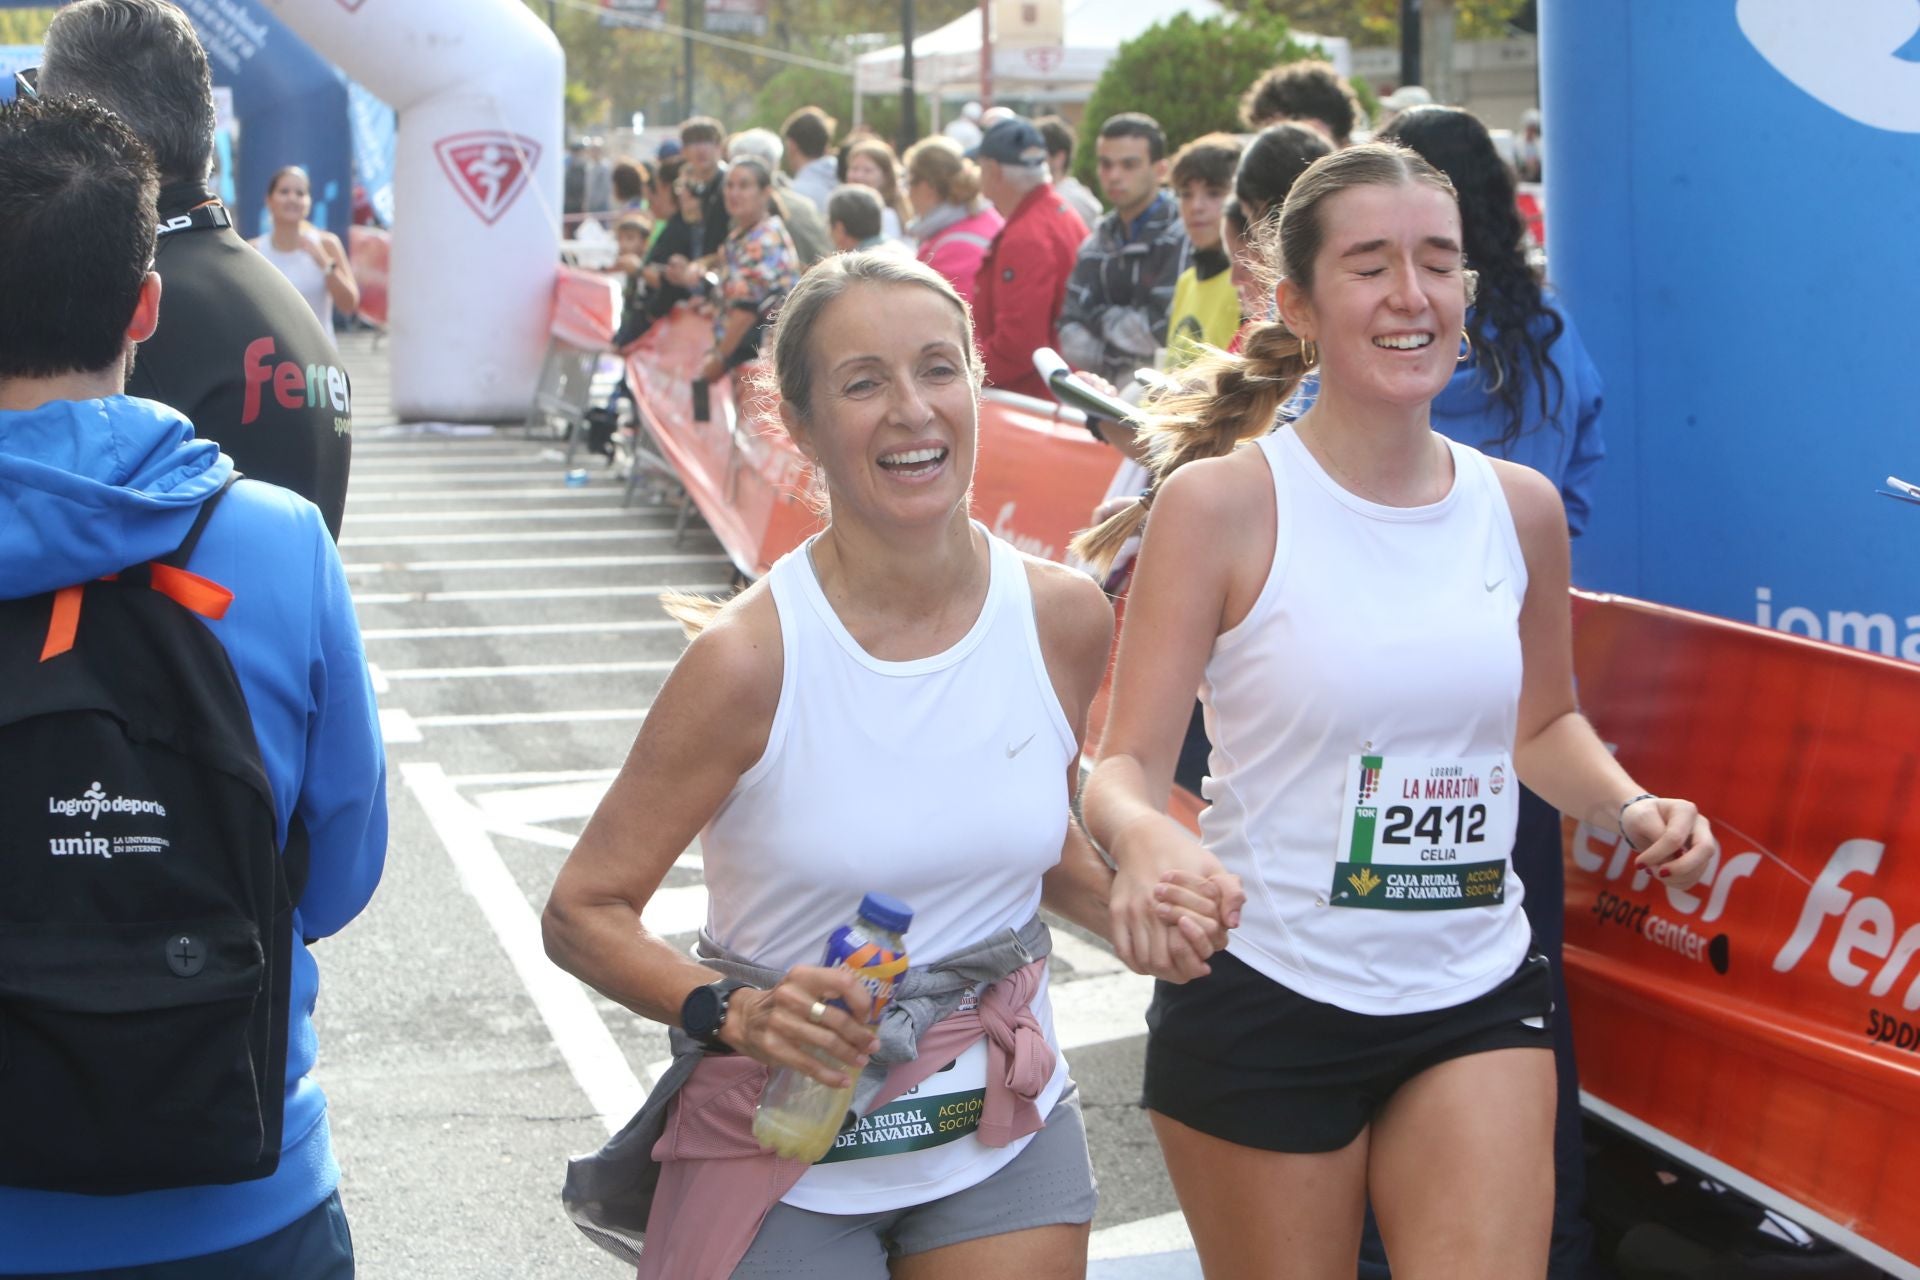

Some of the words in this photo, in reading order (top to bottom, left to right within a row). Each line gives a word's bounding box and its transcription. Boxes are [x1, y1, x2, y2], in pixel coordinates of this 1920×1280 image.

[1403, 778, 1420, 799] LA
[1425, 774, 1479, 799] MARATÓN
[1357, 808, 1376, 818] 10K
[1382, 803, 1487, 845] 2412
[113, 836, 124, 844] LA
[113, 845, 124, 853] EN
[125, 845, 162, 853] INTERNET
[1420, 849, 1457, 861] CELIA
[1386, 873, 1420, 886] CAJA
[1420, 873, 1460, 886] RURAL
[1466, 868, 1500, 882] ACCIÓN
[1384, 886, 1405, 899] DE
[1407, 886, 1463, 899] NAVARRA
[1465, 884, 1497, 897] SOCIAL
[874, 1109, 927, 1128] RURAL
[835, 1134, 858, 1148] DE
[861, 1122, 935, 1145] NAVARRA
